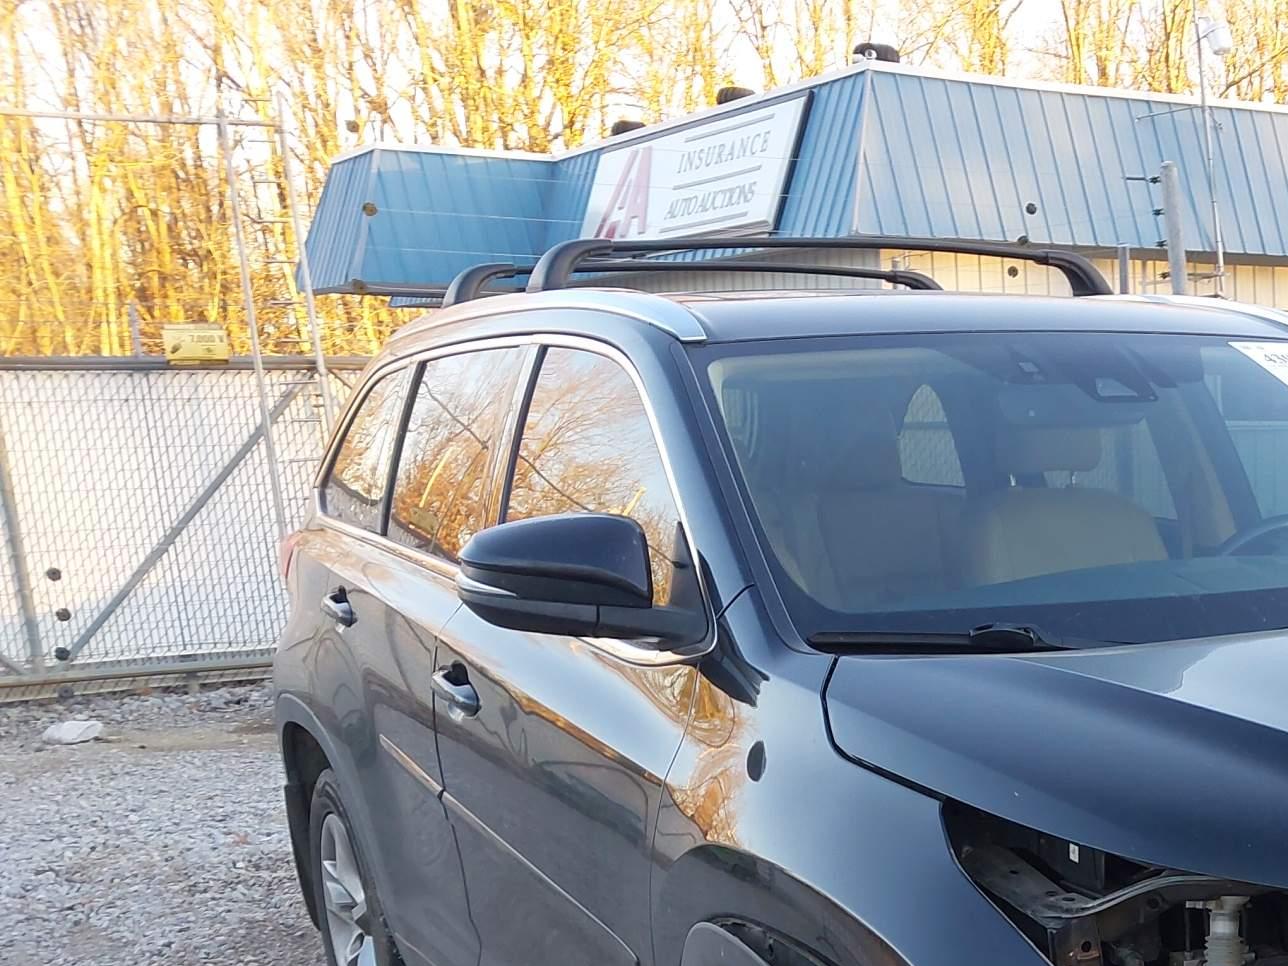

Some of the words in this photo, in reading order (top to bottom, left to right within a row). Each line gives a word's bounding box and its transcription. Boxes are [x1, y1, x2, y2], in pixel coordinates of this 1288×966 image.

[677, 130, 771, 174] INSURANCE
[663, 195, 700, 220] AUTO
[697, 181, 757, 213] AUCTIONS
